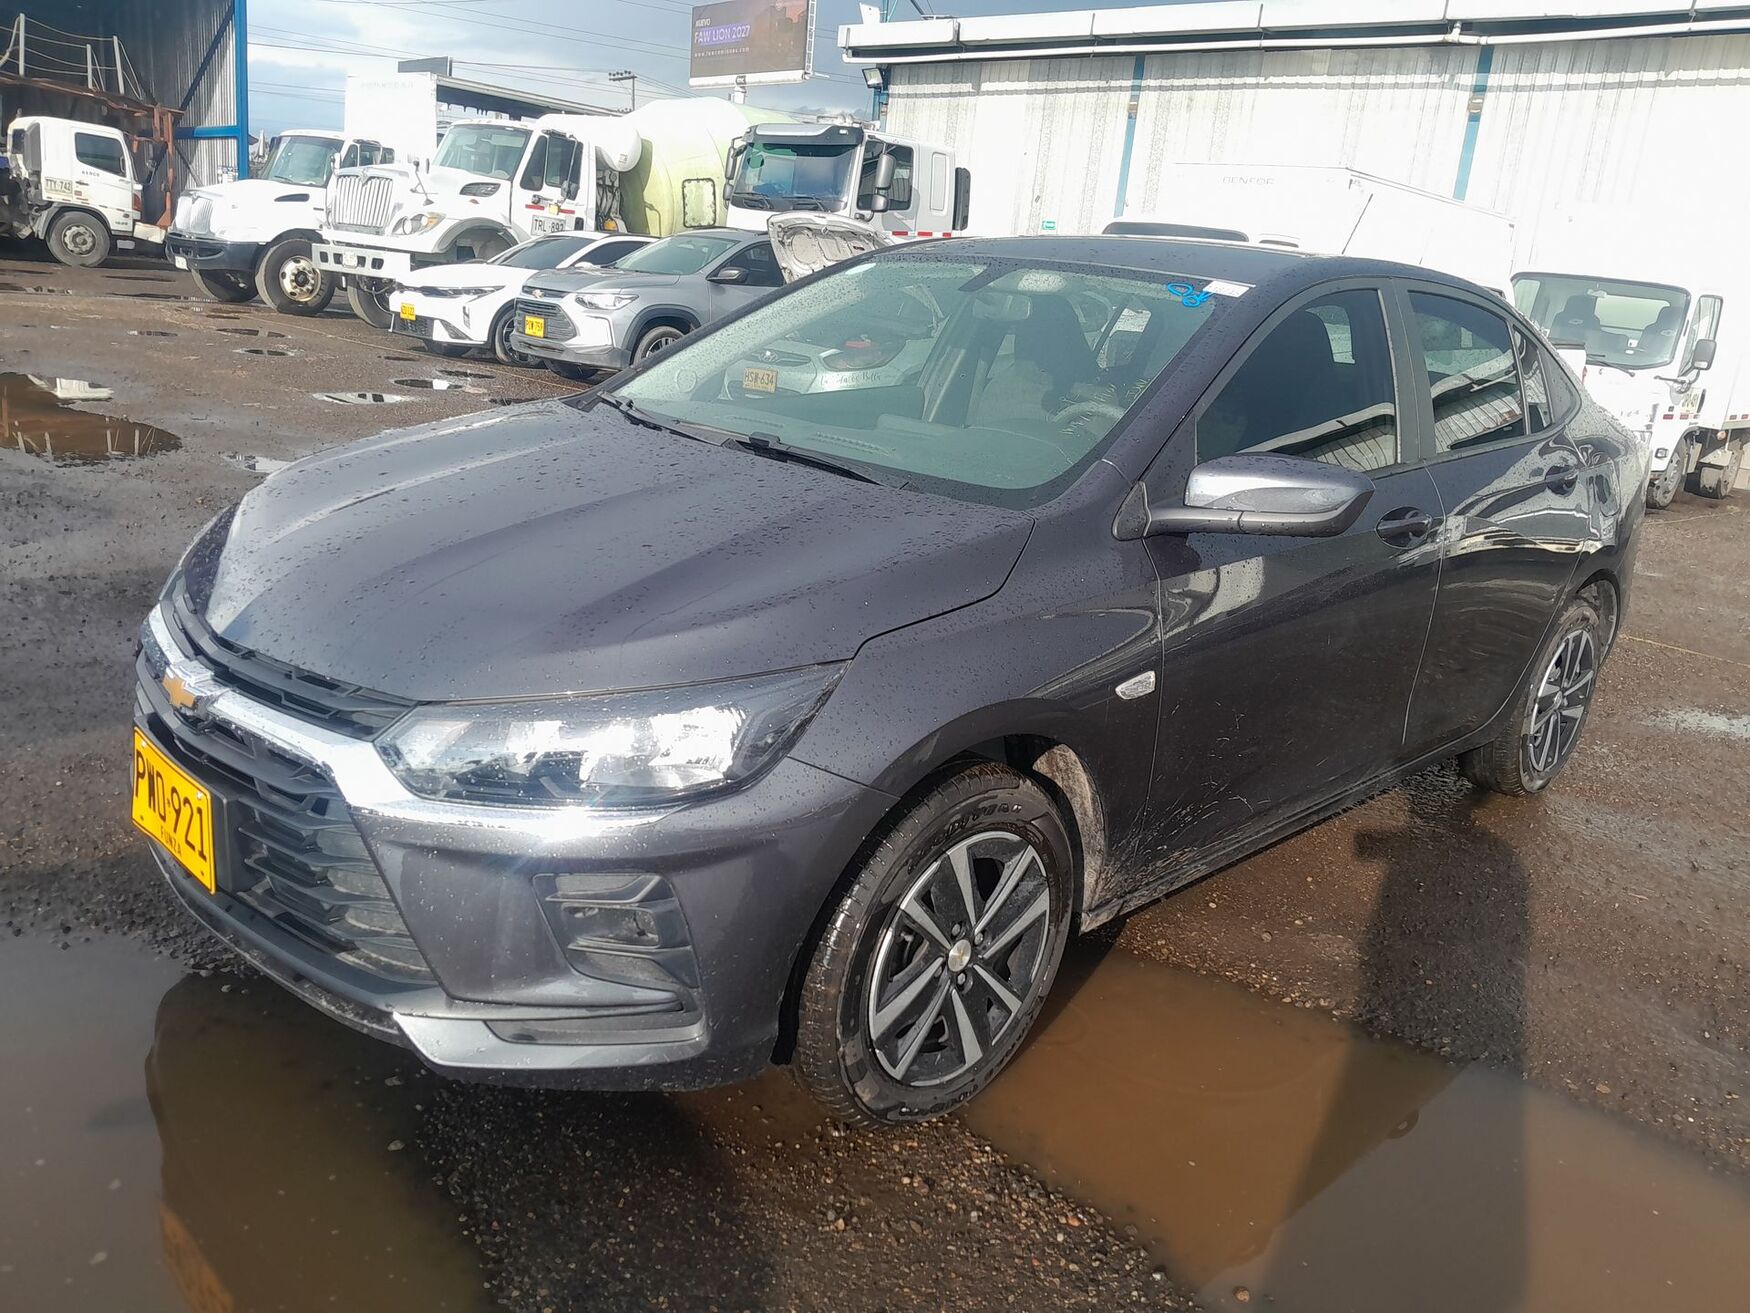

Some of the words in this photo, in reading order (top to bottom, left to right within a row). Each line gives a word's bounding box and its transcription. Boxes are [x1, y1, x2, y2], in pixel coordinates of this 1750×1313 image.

[694, 29, 710, 43] FAW
[712, 27, 731, 41] LION
[732, 25, 750, 39] 2027
